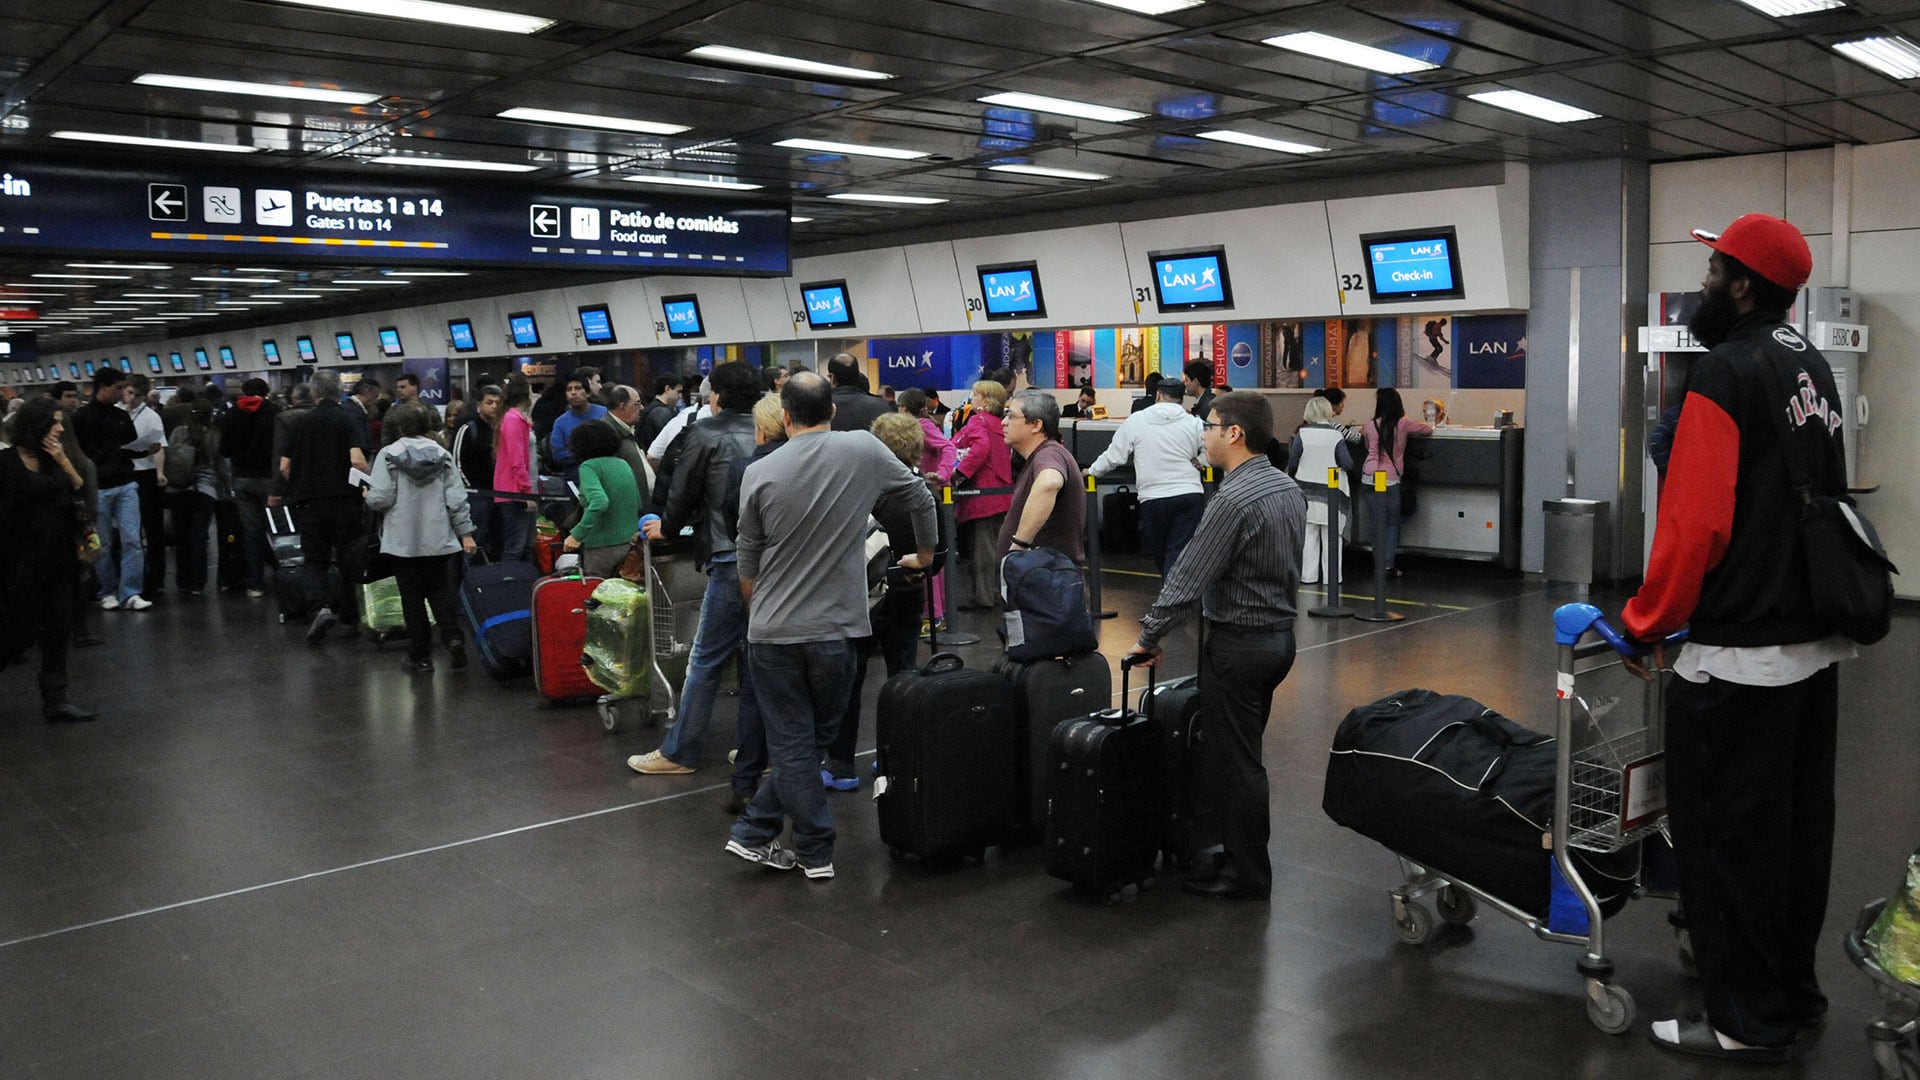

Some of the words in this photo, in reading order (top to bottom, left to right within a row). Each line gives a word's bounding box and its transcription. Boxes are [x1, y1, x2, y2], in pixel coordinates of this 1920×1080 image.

[305, 192, 384, 214] Puertas
[387, 197, 398, 214] 1
[402, 201, 416, 215] a
[419, 199, 443, 217] 14
[306, 214, 346, 230] Gates
[348, 217, 355, 230] 1
[358, 218, 374, 231] to
[375, 218, 392, 232] 14
[610, 209, 652, 229] Patio
[654, 212, 675, 230] de
[676, 215, 739, 234] comidas
[610, 229, 638, 243] Food
[638, 232, 667, 245] court
[1410, 245, 1431, 256] LAN
[1163, 272, 1197, 288] LAN
[1341, 274, 1364, 291] 32
[1391, 269, 1434, 283] Check-in
[988, 285, 1016, 298] LAN
[1135, 287, 1151, 303] 31
[809, 300, 831, 312] LAN
[967, 298, 983, 312] 30
[668, 311, 686, 322] LAN
[794, 310, 807, 323] 29
[655, 321, 666, 332] 28
[1832, 327, 1851, 346] HSBC
[1469, 341, 1507, 355] LAN
[888, 355, 916, 369] LAN
[1216, 325, 1226, 386] USHUAIA
[418, 389, 443, 399] AN
